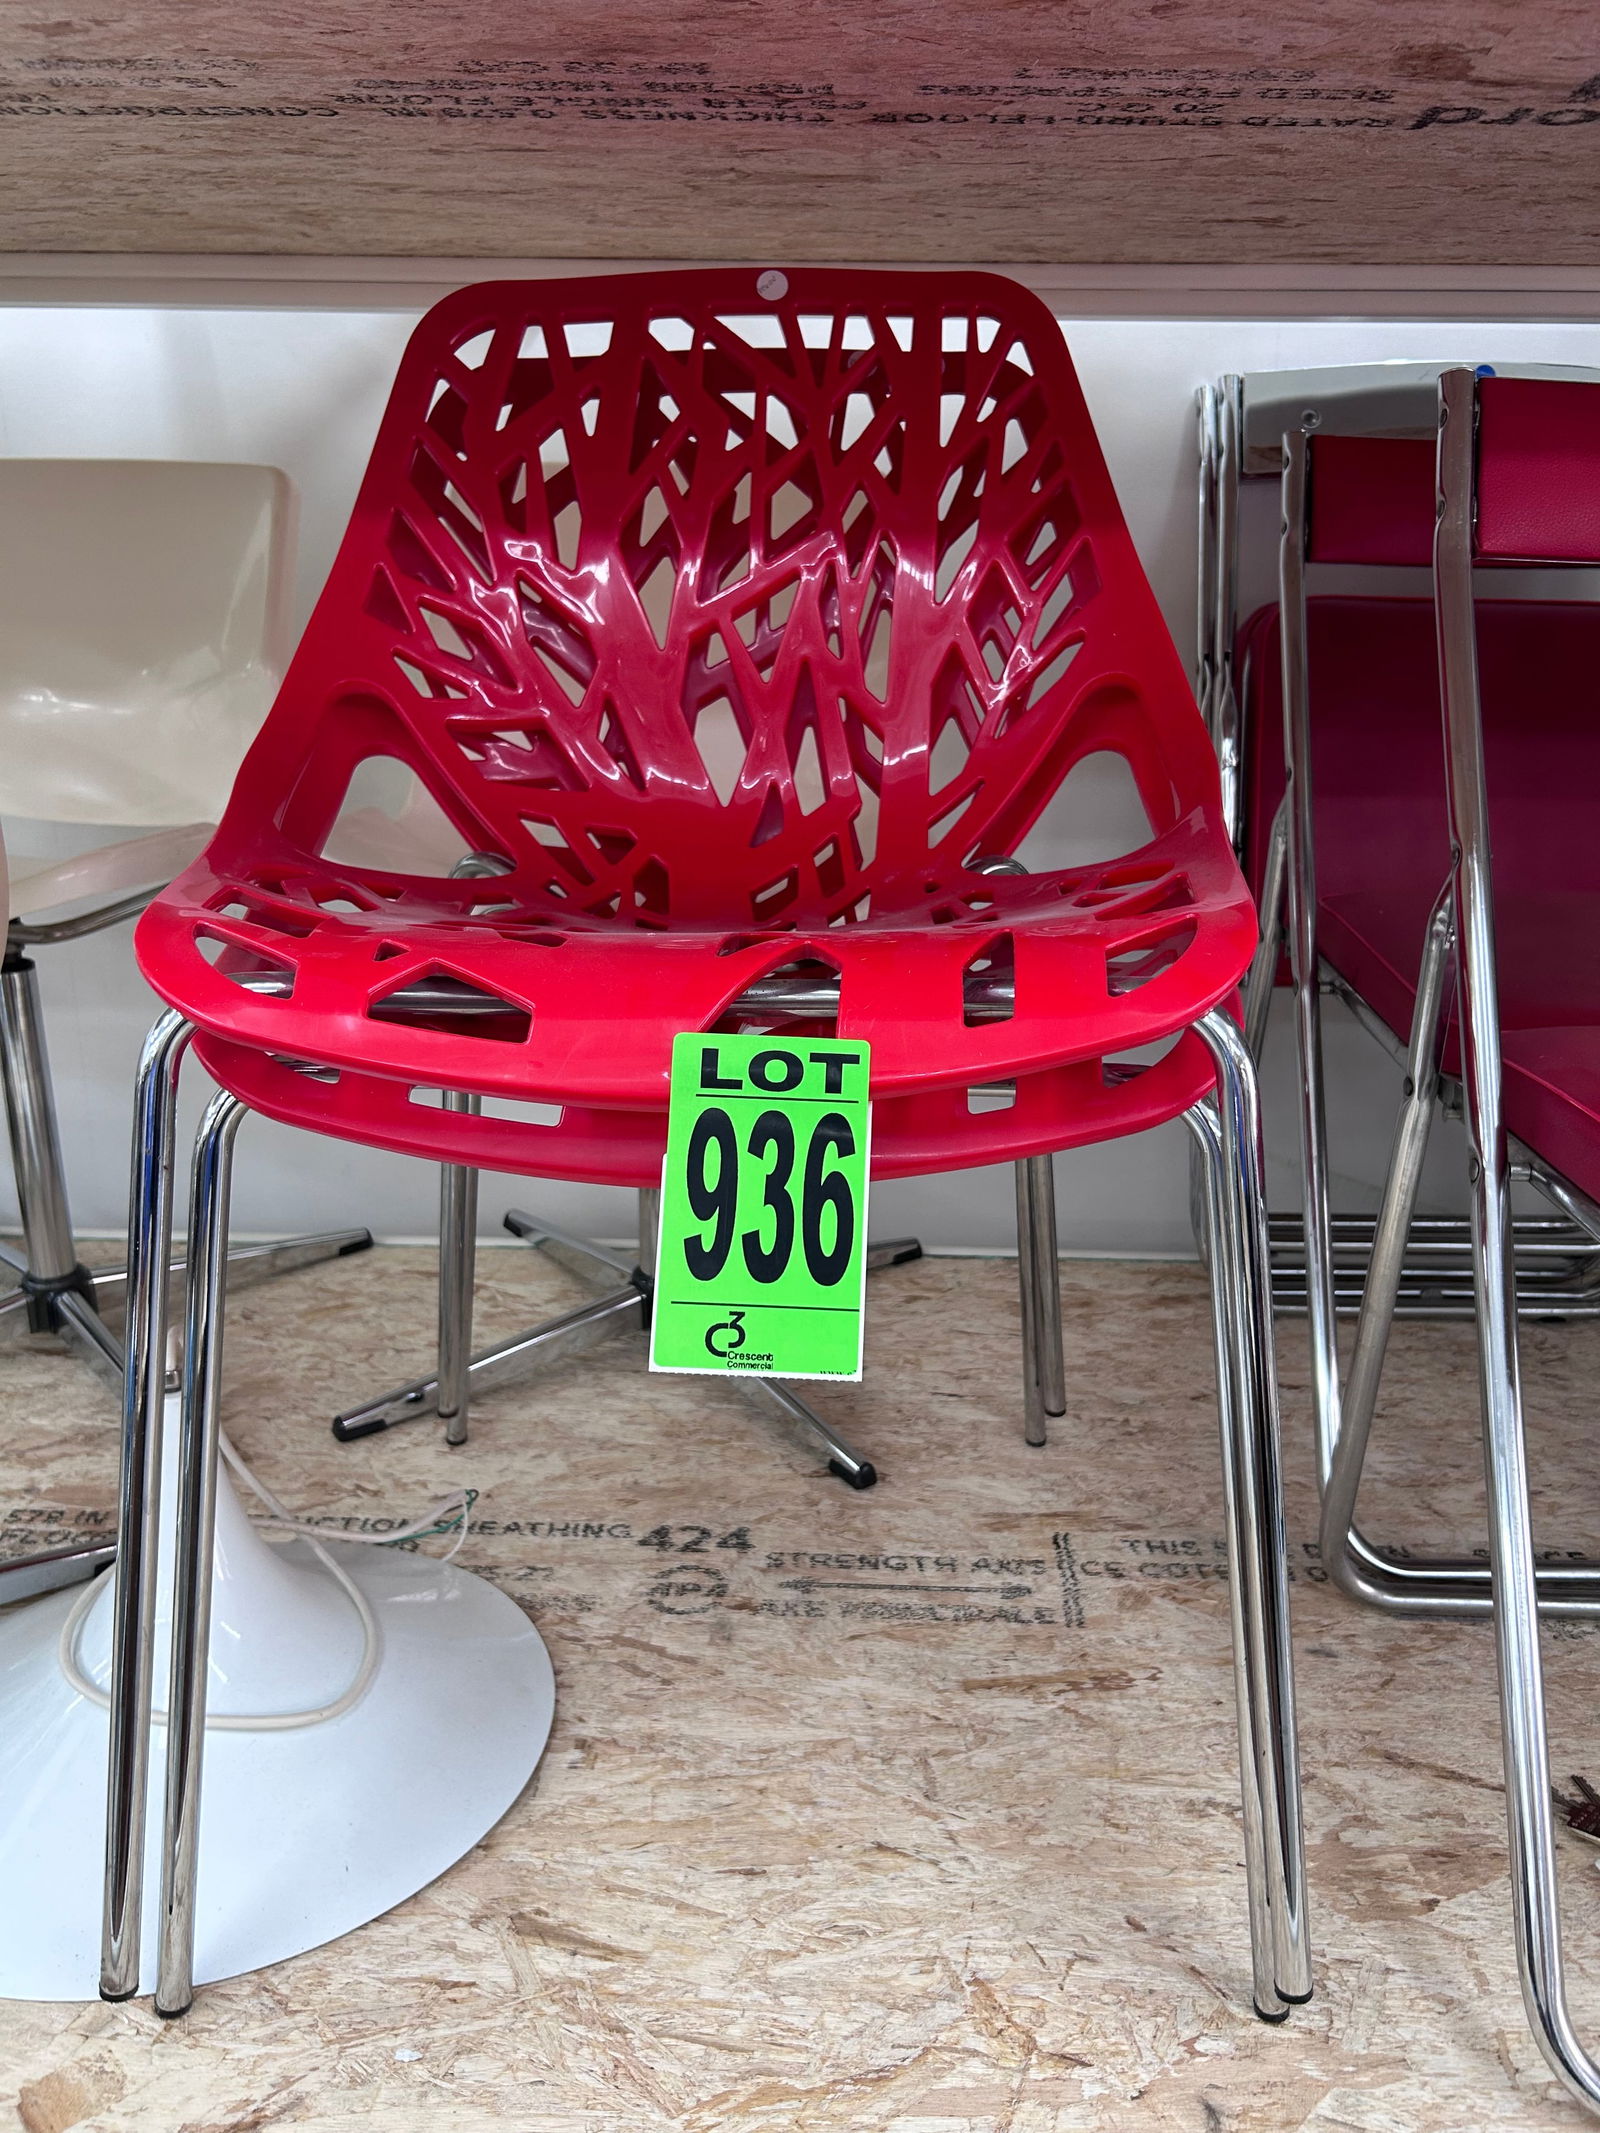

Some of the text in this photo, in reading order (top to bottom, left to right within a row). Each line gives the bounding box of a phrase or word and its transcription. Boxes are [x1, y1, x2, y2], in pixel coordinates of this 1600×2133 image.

[581, 109, 834, 122] THICKNESS
[700, 1047, 861, 1095] LOT
[683, 1107, 856, 1287] 936
[727, 1350, 774, 1362] Crescent
[637, 1524, 756, 1553] 424
[1120, 1538, 1202, 1557] THIS
[765, 1551, 959, 1573] STRENGTH
